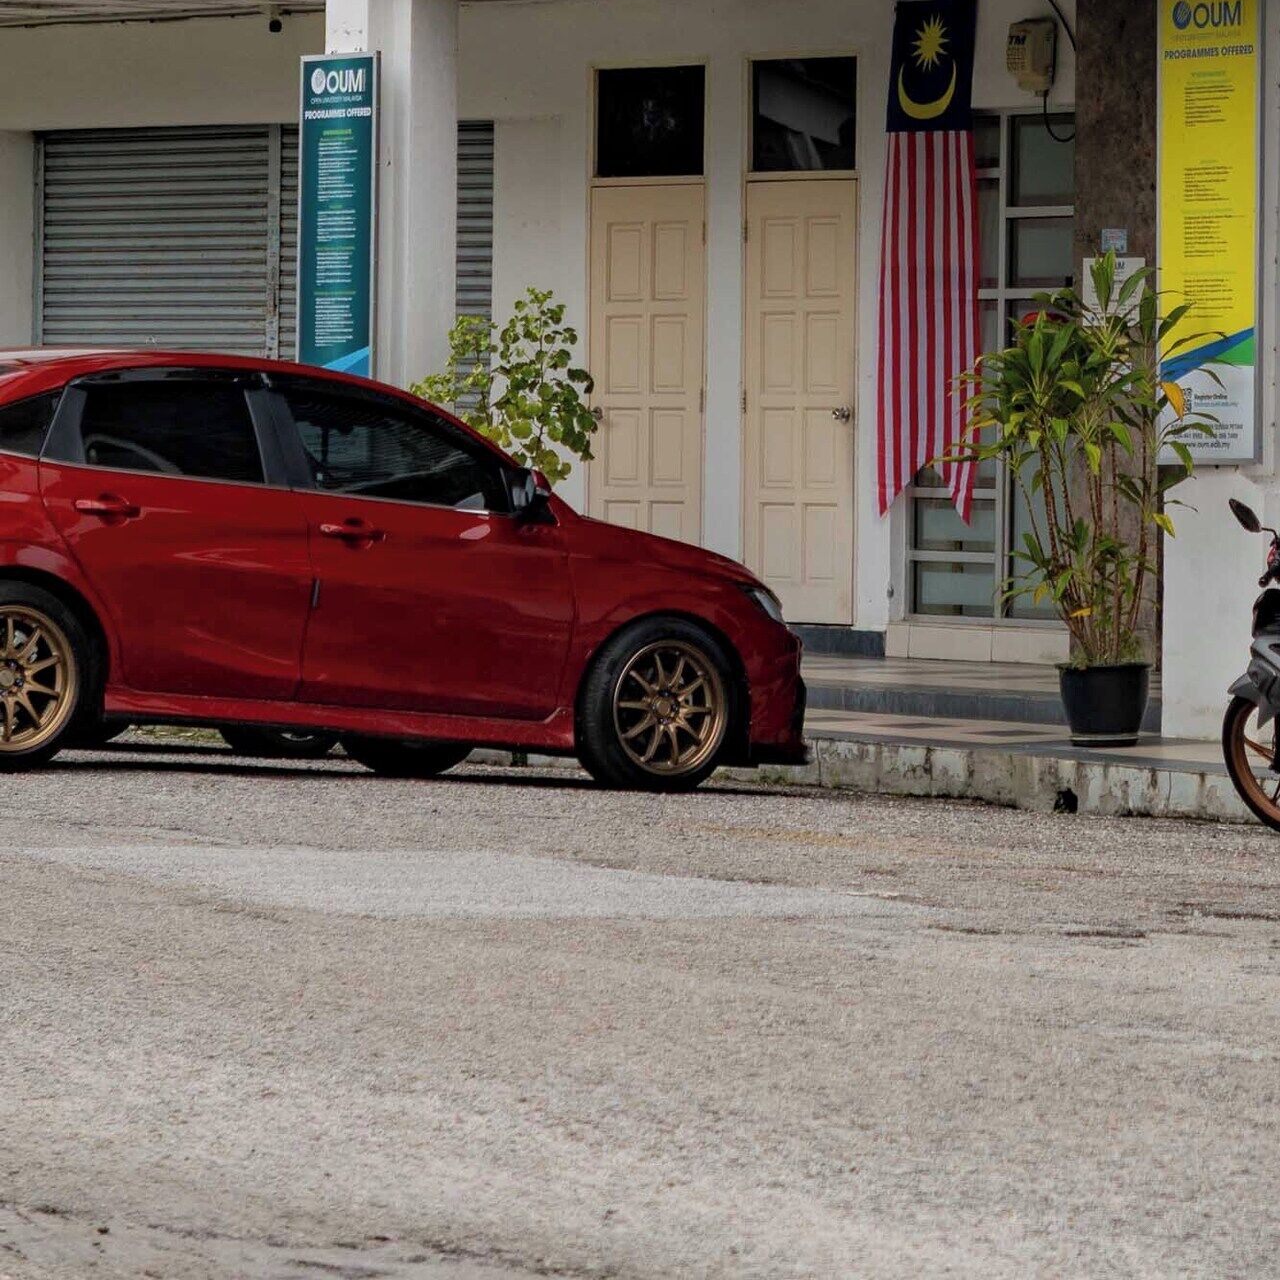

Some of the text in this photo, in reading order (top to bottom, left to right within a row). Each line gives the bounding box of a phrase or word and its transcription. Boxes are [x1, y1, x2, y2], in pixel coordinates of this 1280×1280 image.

[1193, 0, 1242, 28] OUM
[1164, 44, 1254, 60] PROGRAMMES OFFERED
[326, 68, 363, 93] OUM
